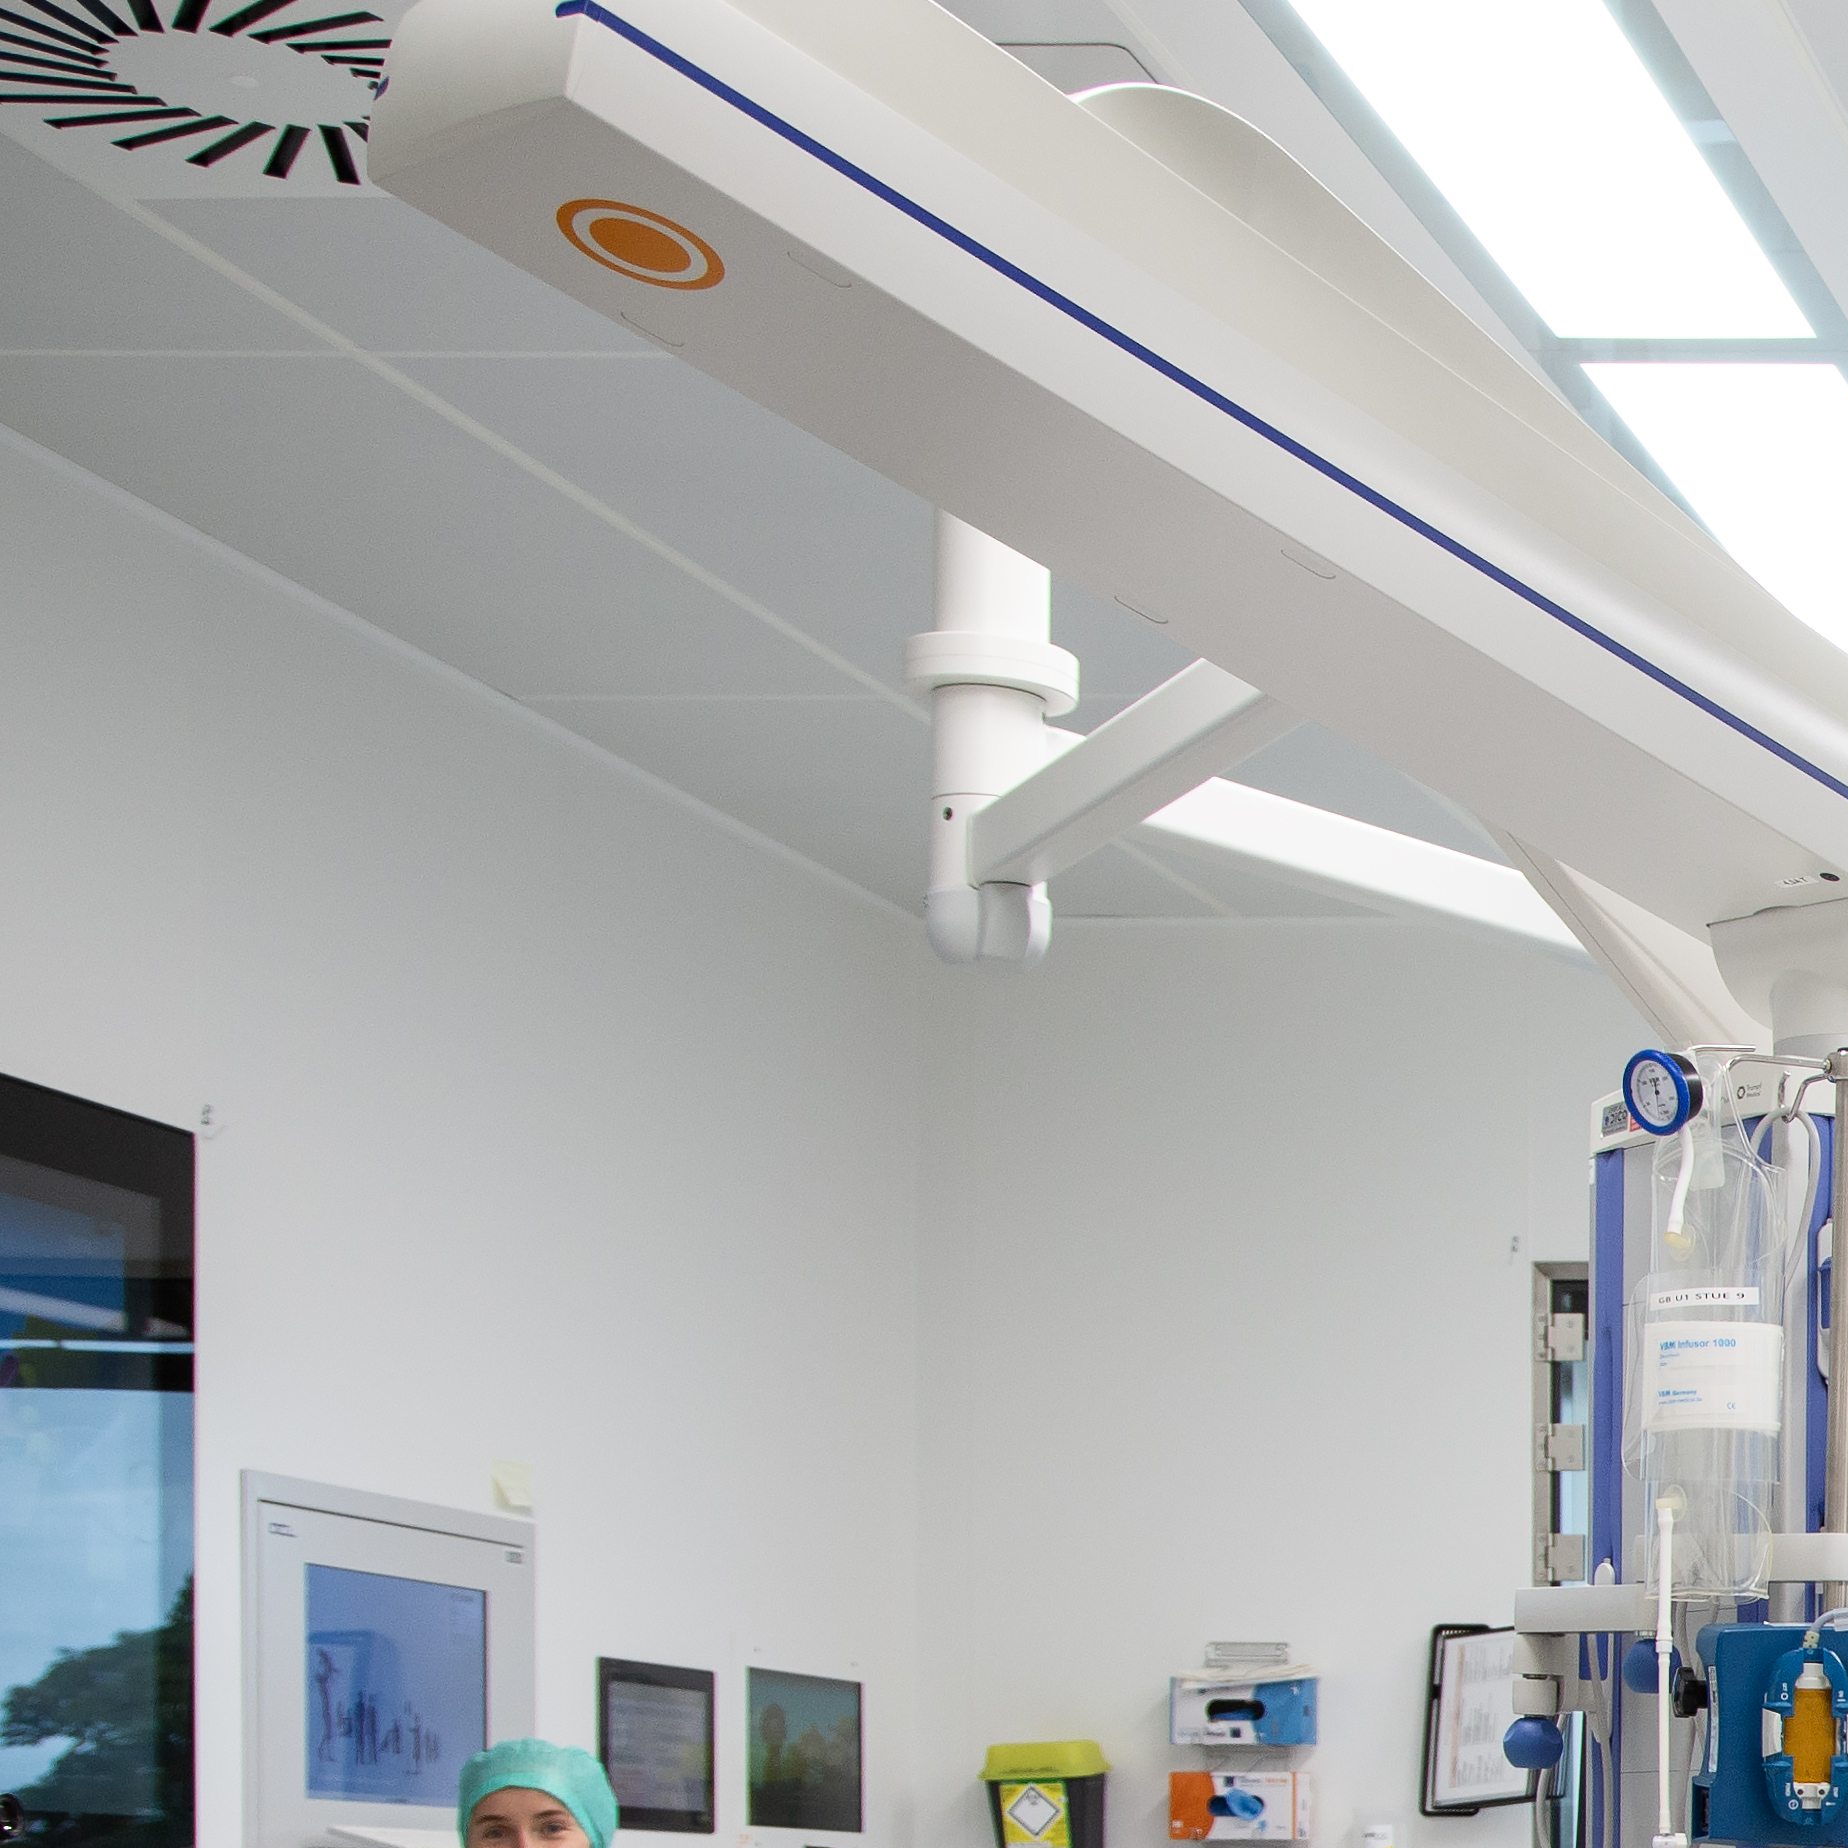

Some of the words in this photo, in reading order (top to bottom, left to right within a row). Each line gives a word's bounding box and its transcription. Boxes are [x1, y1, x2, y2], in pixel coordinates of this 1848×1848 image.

[1675, 1294, 1688, 1302] U1
[1695, 1292, 1730, 1300] STUE
[1659, 1341, 1675, 1350] VBM
[1678, 1339, 1709, 1348] Infusor
[1713, 1338, 1736, 1348] 1000
